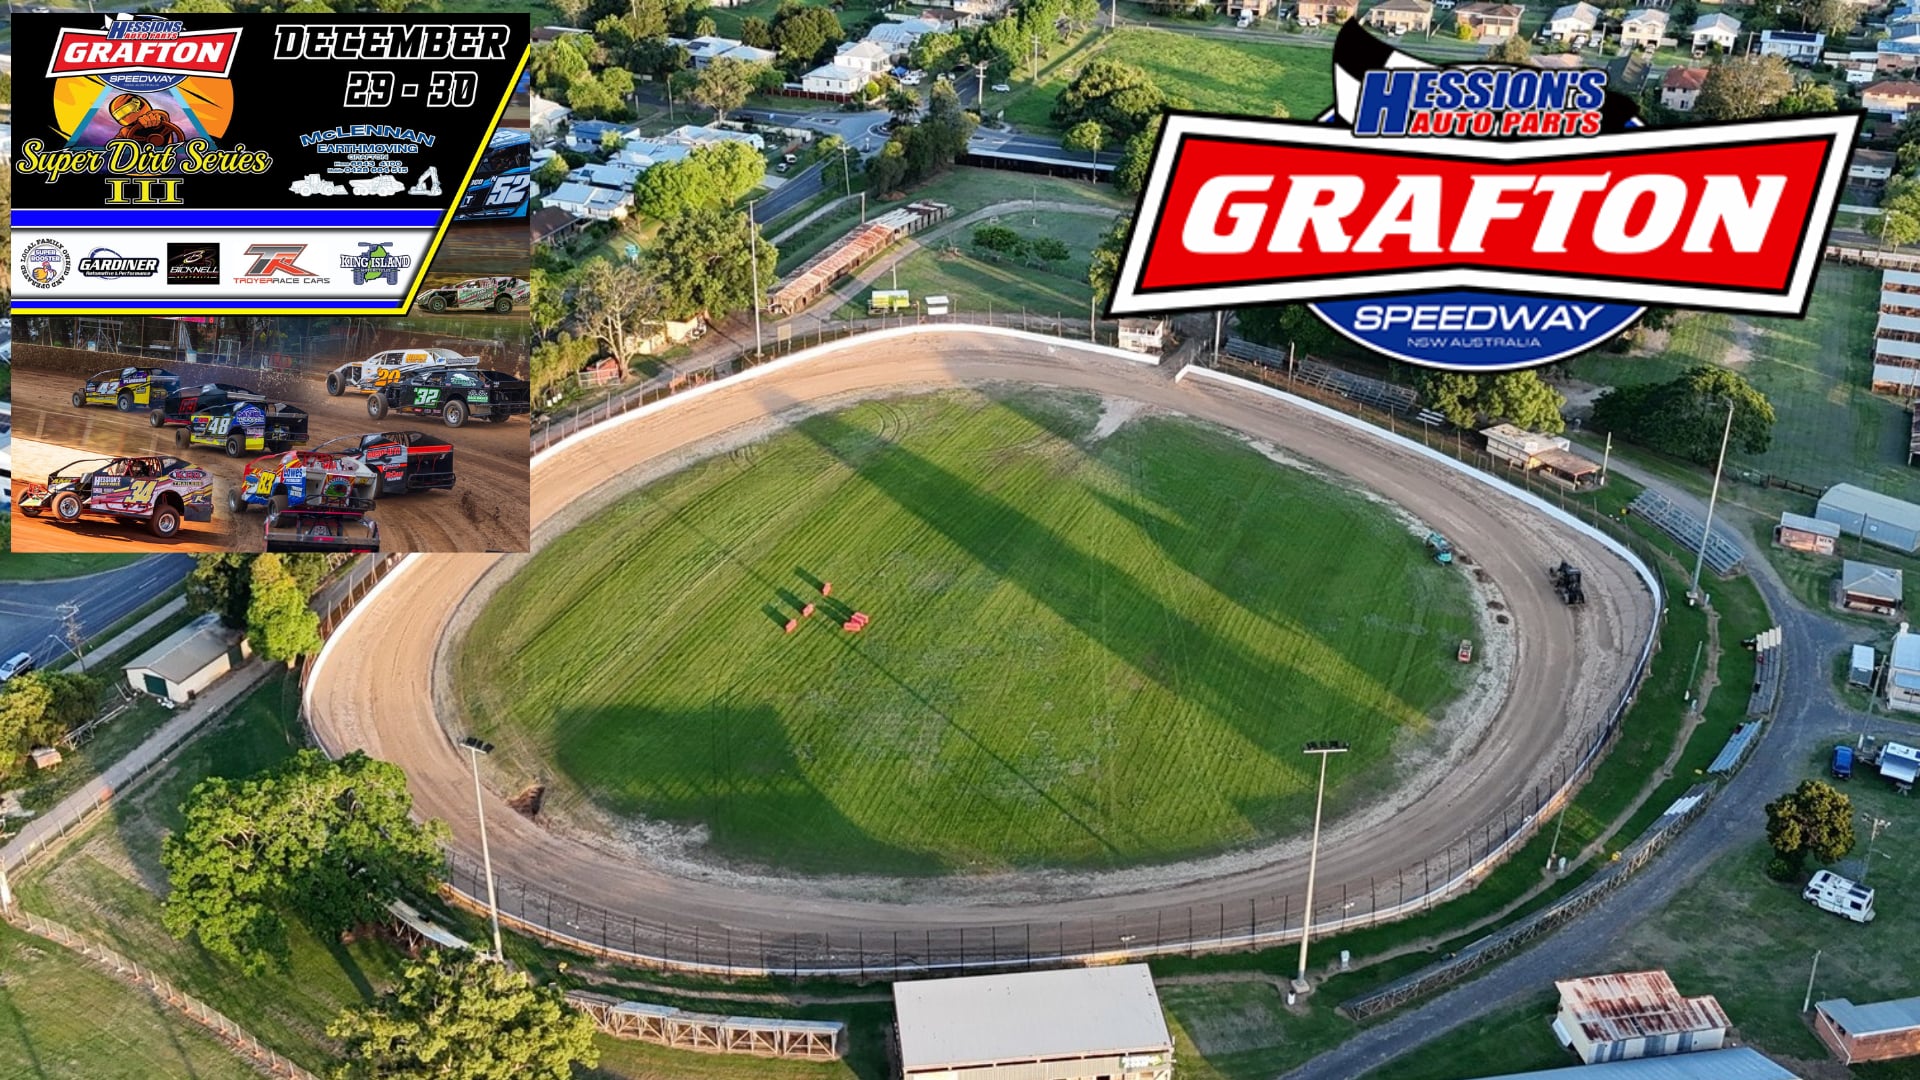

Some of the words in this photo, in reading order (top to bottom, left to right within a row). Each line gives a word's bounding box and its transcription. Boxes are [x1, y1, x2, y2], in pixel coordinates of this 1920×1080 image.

[485, 174, 530, 206] 52
[97, 381, 120, 395] 42
[414, 387, 440, 406] 32
[208, 417, 231, 435] 48
[124, 479, 157, 503] 34
